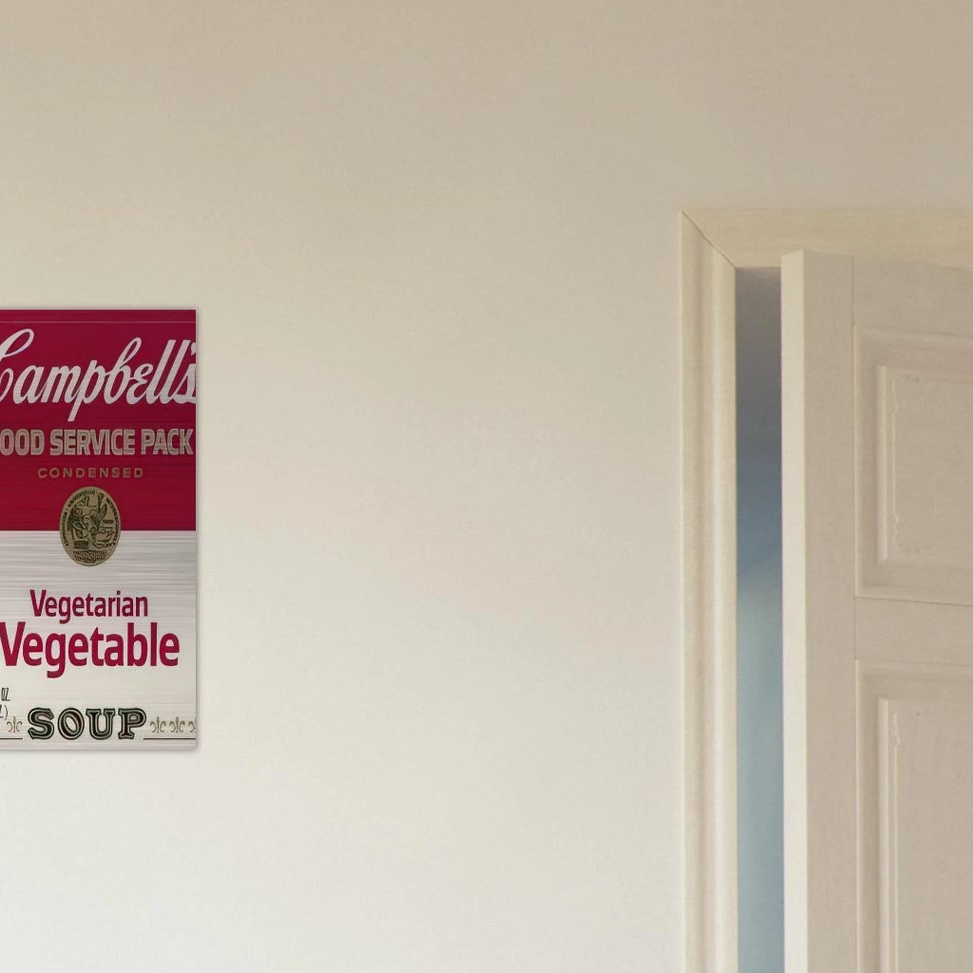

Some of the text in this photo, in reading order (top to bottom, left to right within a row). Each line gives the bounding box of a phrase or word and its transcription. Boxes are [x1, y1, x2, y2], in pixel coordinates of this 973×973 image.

[50, 428, 136, 455] SERVICE
[141, 428, 194, 455] PACK
[38, 467, 144, 478] CONDENSED
[29, 589, 148, 624] Vegetarian
[1, 688, 10, 701] OZ.
[27, 708, 147, 740] SOUP
